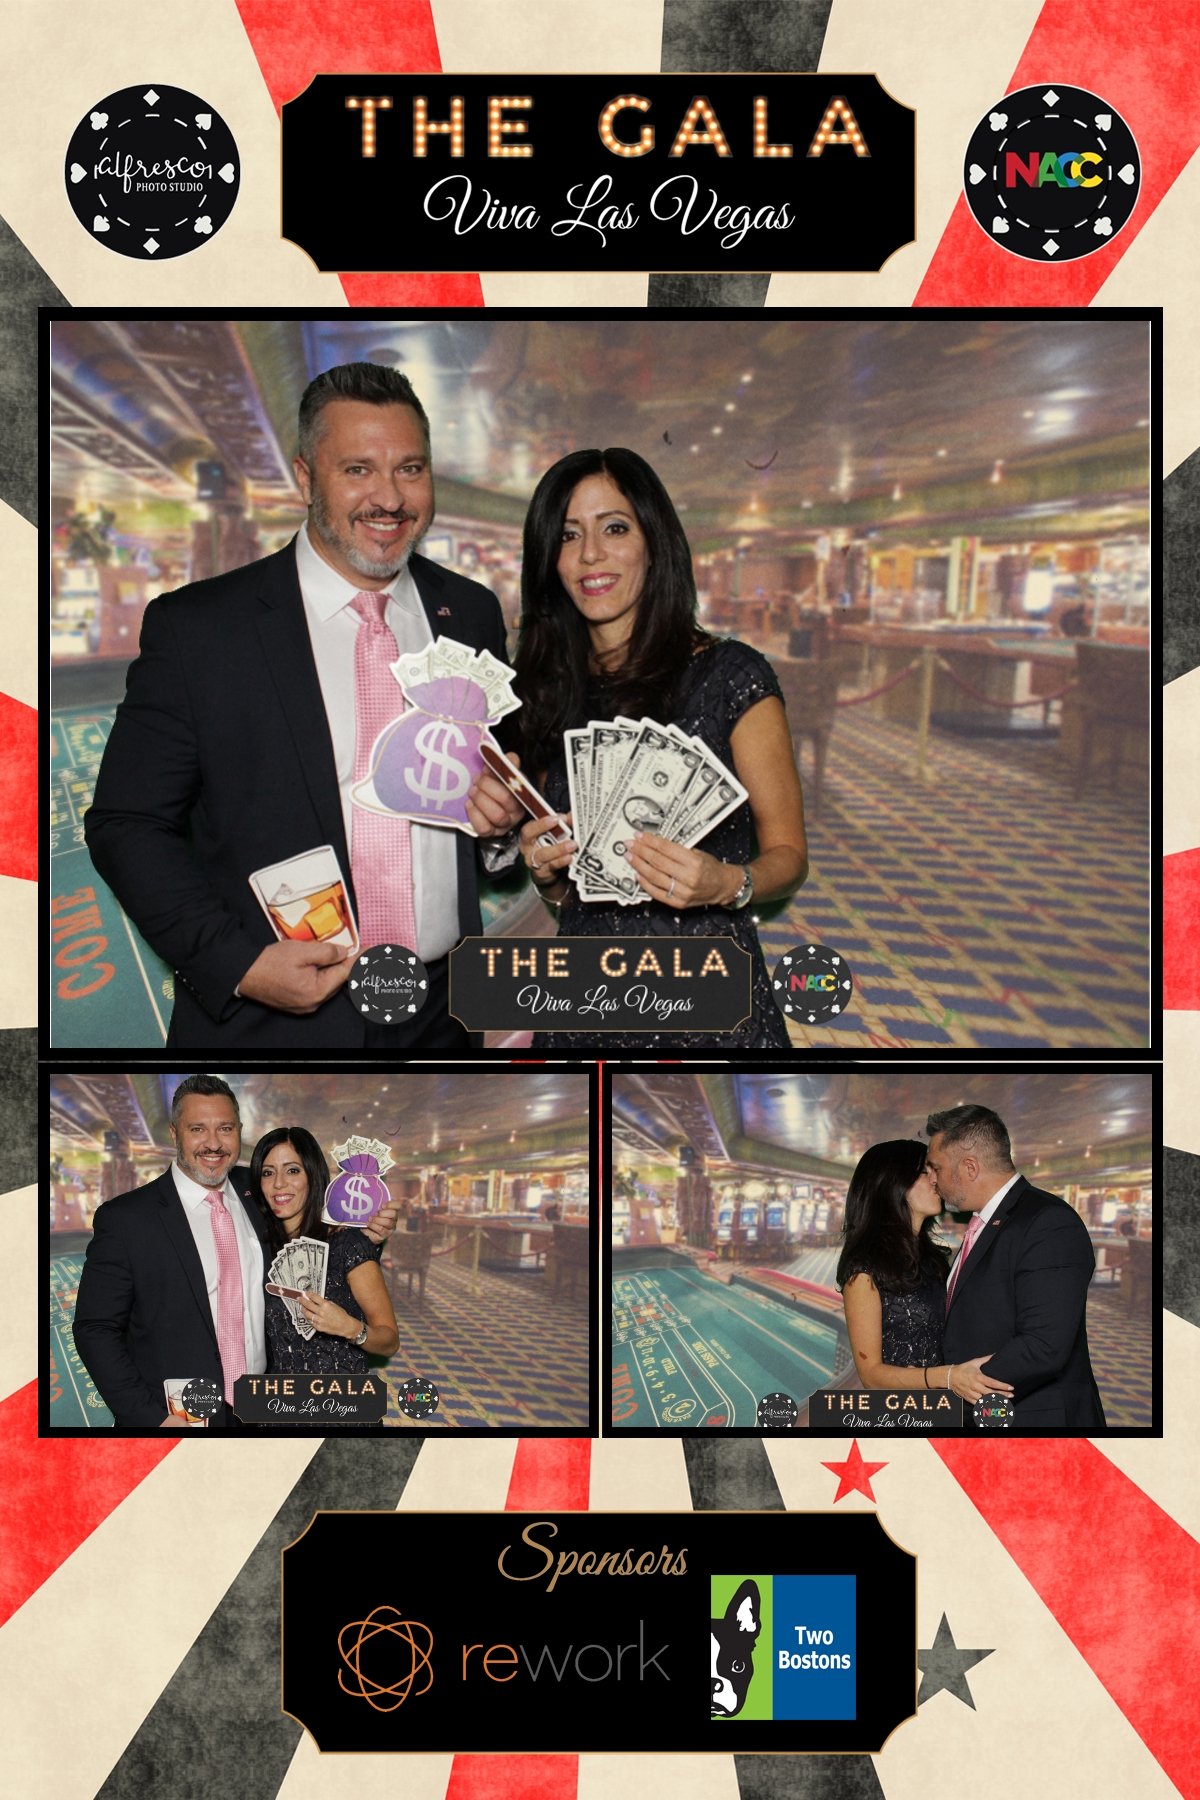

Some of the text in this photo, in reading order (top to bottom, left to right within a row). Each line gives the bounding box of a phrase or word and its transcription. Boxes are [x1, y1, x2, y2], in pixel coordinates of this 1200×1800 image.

[51, 887, 116, 1001] COME
[692, 1341, 720, 1369] PASS LINE
[642, 1357, 655, 1366] 10
[661, 1357, 678, 1376] FIELD
[645, 1369, 659, 1377] 9
[651, 1381, 665, 1389] 4
[661, 1393, 676, 1403] 3
[675, 1402, 691, 1413] 2
